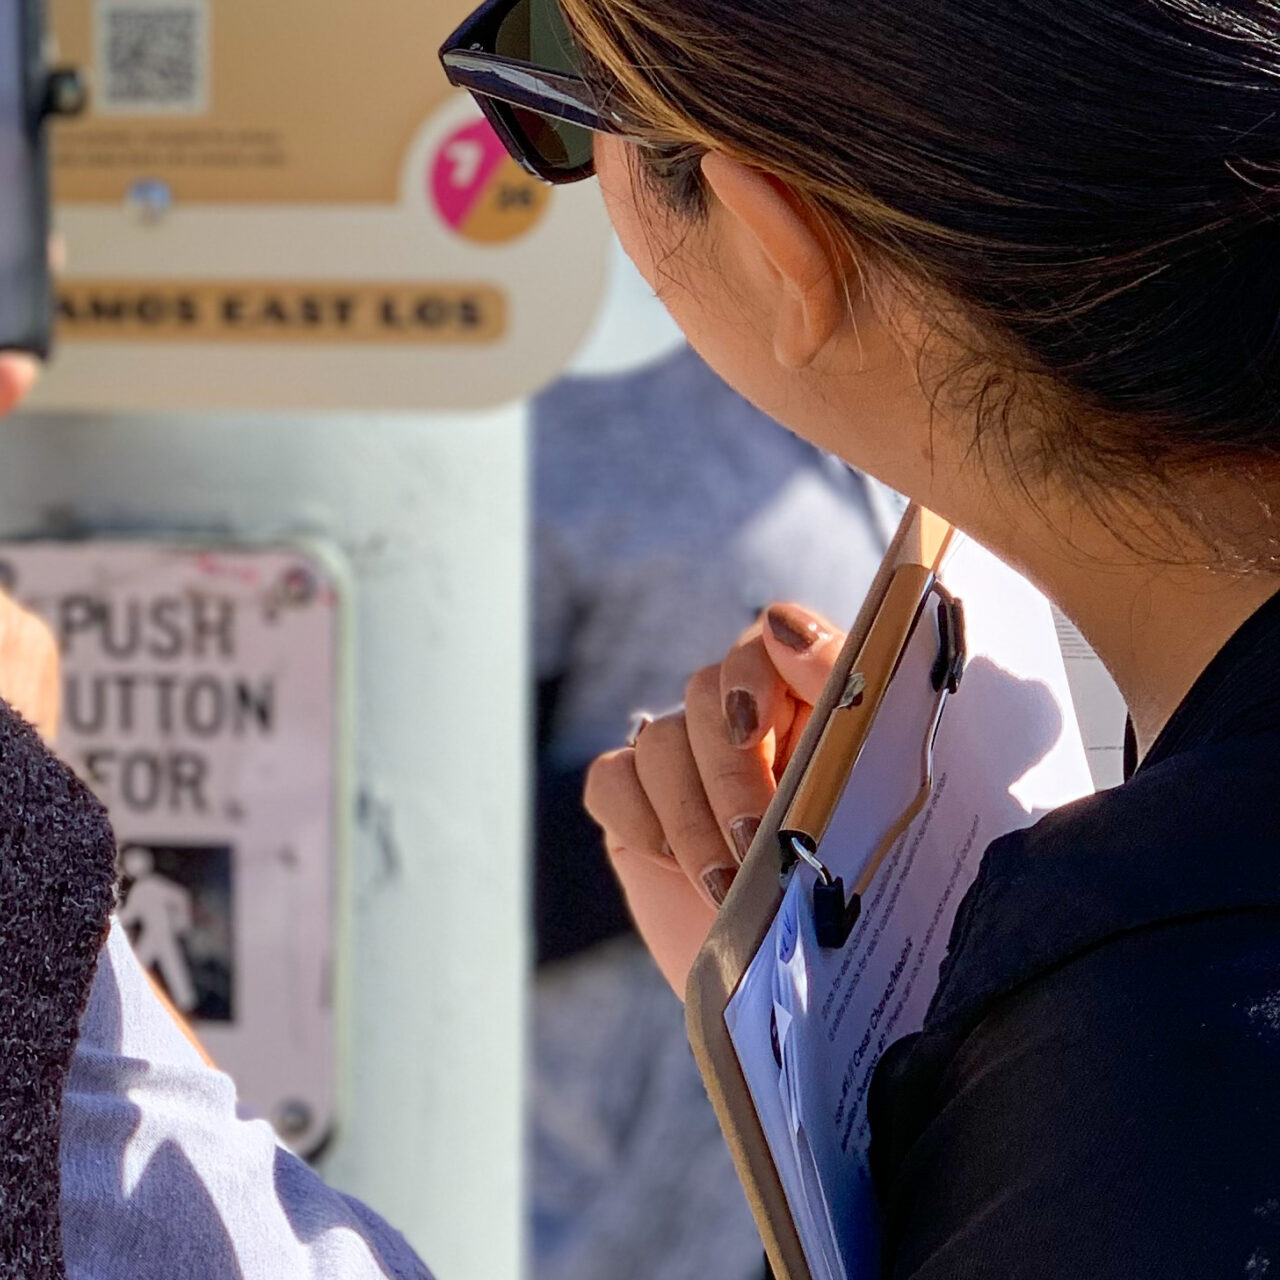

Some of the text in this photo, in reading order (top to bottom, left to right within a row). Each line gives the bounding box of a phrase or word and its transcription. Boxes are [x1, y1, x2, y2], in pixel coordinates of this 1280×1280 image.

[54, 291, 484, 331] AMOS EAST LOS
[60, 593, 236, 663] PUSH
[65, 673, 276, 740] UTTON
